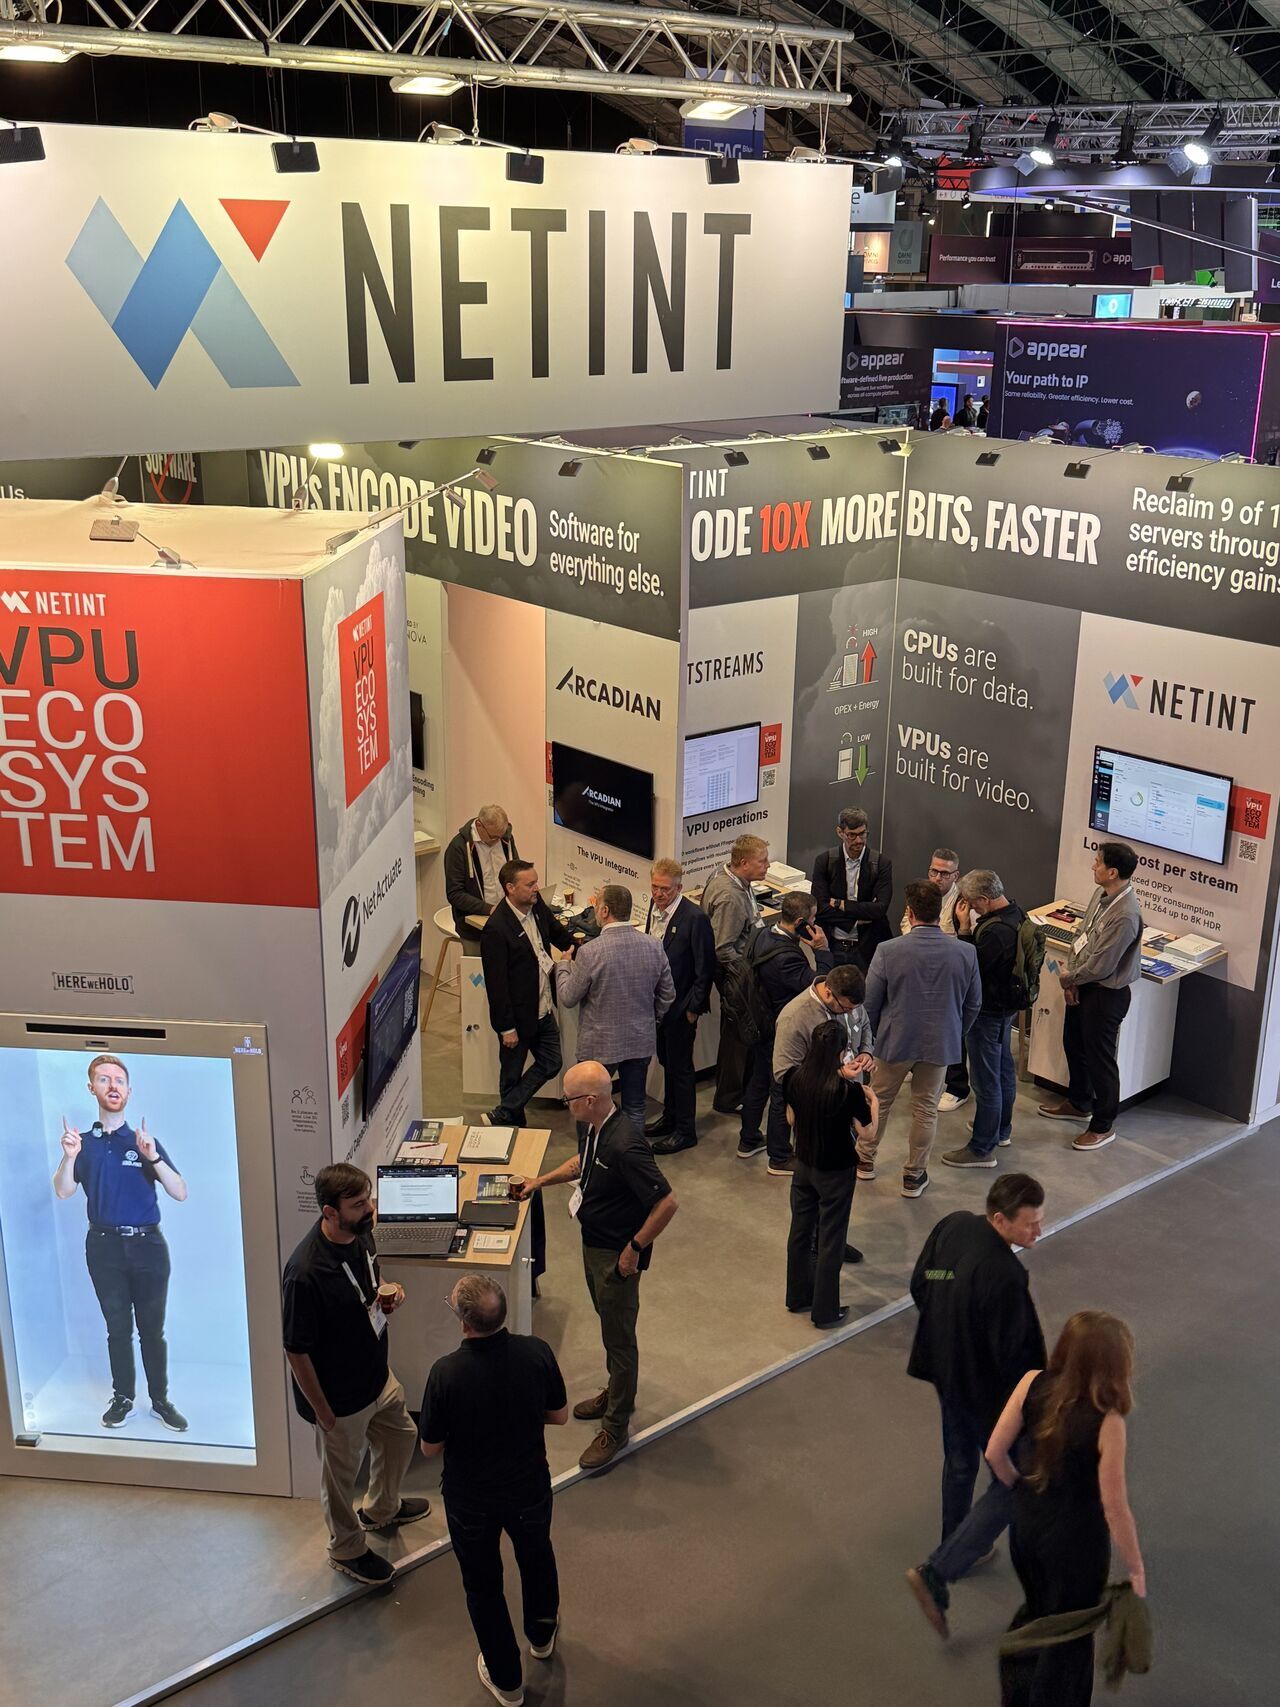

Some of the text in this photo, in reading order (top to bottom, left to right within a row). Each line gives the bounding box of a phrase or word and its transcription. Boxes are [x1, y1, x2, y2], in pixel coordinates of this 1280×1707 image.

[939, 254, 968, 262] Performance
[968, 255, 977, 263] you
[985, 254, 997, 262] trust
[1112, 252, 1132, 266] app
[341, 201, 751, 385] NETINT
[861, 352, 904, 370] appear
[1027, 342, 1088, 361] appear
[887, 373, 913, 383] production
[1006, 370, 1089, 388] Your path to IP
[260, 450, 538, 567] VPUs ENCODE VIDEO
[1132, 486, 1215, 521] Reclaim
[1220, 497, 1234, 522] 9
[1239, 500, 1265, 526] of
[549, 509, 640, 554] Software for
[691, 489, 1101, 565] ODE 10X MORE BITS, FASTER
[1128, 522, 1204, 550] servers
[550, 551, 665, 597] everything else.
[1126, 548, 1226, 591] efficiency
[34, 591, 107, 617] NETINT
[358, 613, 373, 639] NETINT
[862, 628, 878, 638] HIGH
[0, 625, 140, 691] VPU
[353, 635, 374, 680] VPU
[903, 628, 998, 671] CPUs are
[687, 651, 764, 685] TSTREAMS
[902, 655, 1034, 710] built for data.
[355, 669, 376, 713] ECO
[555, 665, 661, 722] ARCADIAN
[834, 703, 853, 716] OPEX
[858, 699, 880, 713] Energy
[1149, 679, 1257, 735] NETINT
[0, 689, 145, 752] ECO
[356, 700, 377, 744] SYS
[764, 735, 777, 743] VPU
[857, 733, 871, 743] LOW
[897, 723, 989, 770] VPUs are
[357, 735, 379, 776] TEM
[0, 750, 150, 814] SYS
[581, 785, 622, 808] ARCADIAN
[896, 750, 1035, 813] built for video.
[686, 808, 769, 838] VPU operations
[1246, 801, 1263, 811] VPU
[1, 810, 156, 873] TEM
[1244, 819, 1260, 830] TEM
[577, 845, 640, 879] The VPU Integrator.
[1163, 863, 1186, 878] per
[1189, 870, 1239, 894] stream
[362, 857, 402, 925] NetActuate
[1136, 888, 1162, 903] energy
[1162, 895, 1215, 918] consumption
[1151, 880, 1173, 894] OPEX
[1144, 900, 1167, 915] H.264
[1168, 911, 1179, 920] up
[1180, 911, 1189, 922] to
[1190, 915, 1202, 925] 8K
[1202, 918, 1221, 932] HDR
